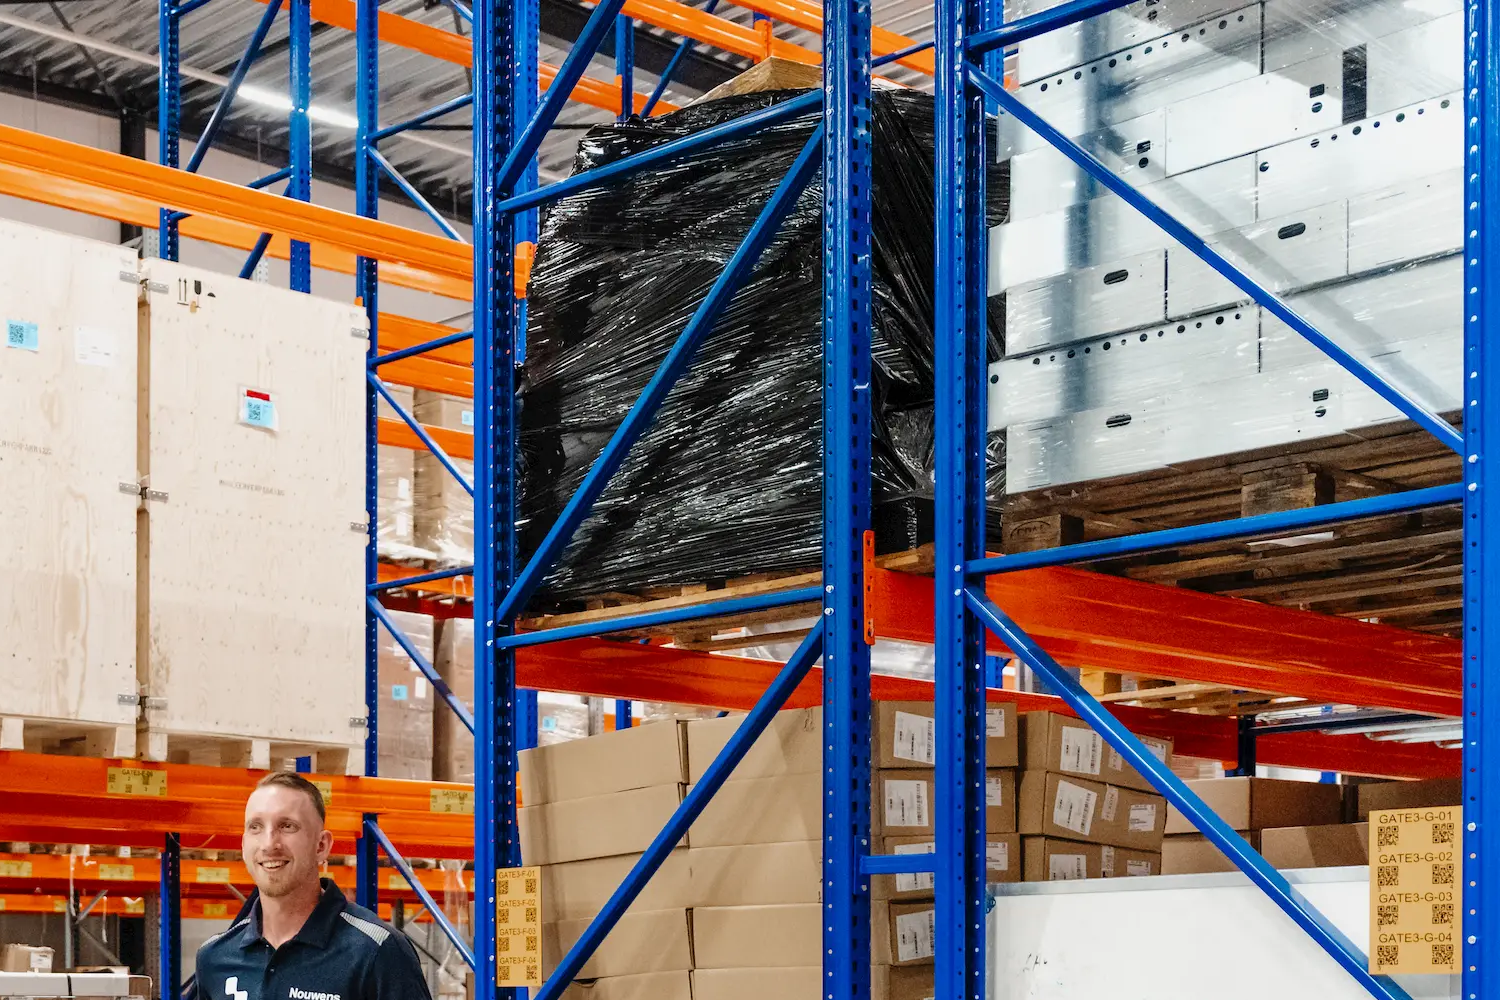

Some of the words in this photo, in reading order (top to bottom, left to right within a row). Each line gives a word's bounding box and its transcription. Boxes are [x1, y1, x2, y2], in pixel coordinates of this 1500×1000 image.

[1379, 811, 1452, 824] GATE3-G-01
[1379, 852, 1453, 864] GATE3-G-02
[499, 870, 535, 879] GATE3-F-01
[1379, 892, 1453, 903] GATE3-G-03
[499, 899, 536, 908] GATE3-F-02
[499, 928, 536, 936] GATE3-F-03
[1379, 932, 1453, 944] GATE3-G-04
[499, 957, 536, 965] GATE3-F-04
